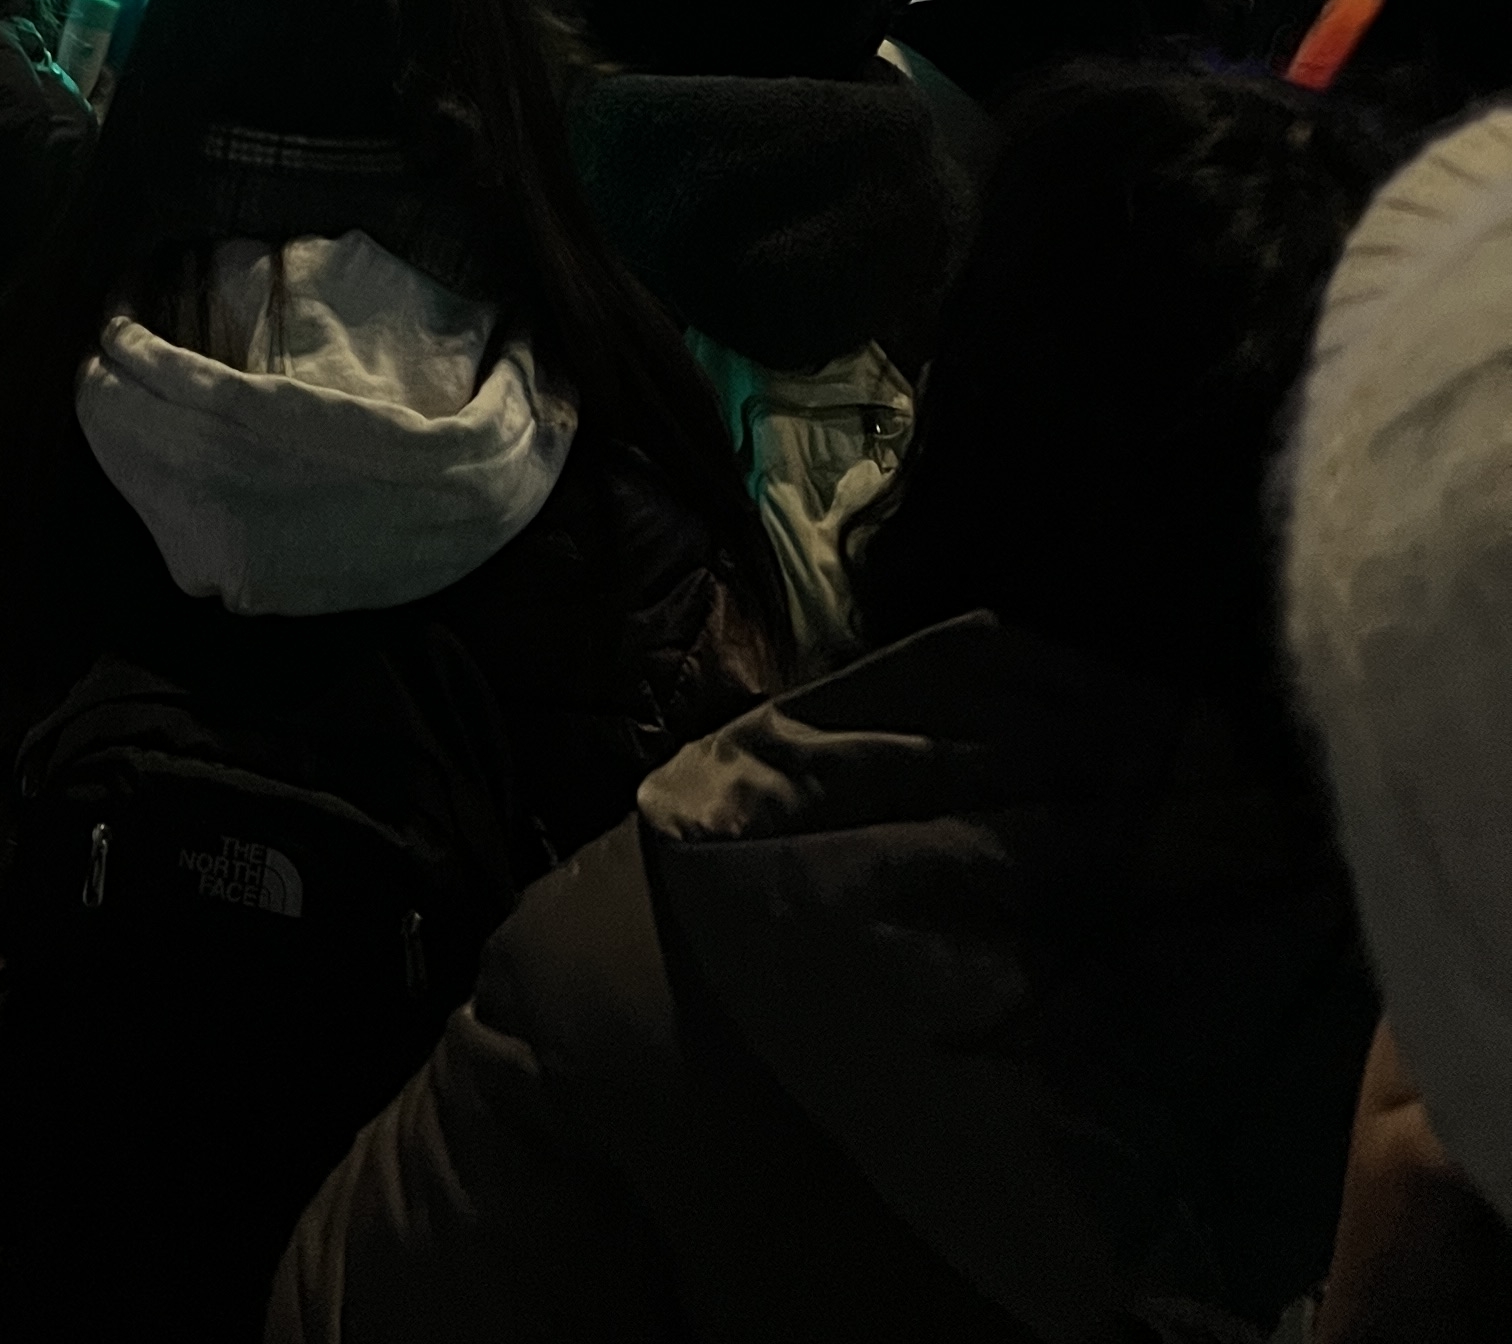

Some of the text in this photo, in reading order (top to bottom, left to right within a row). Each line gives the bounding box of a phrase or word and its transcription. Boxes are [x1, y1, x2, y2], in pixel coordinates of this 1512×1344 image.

[222, 834, 267, 864] THE
[179, 848, 262, 886] NORTH
[199, 873, 259, 908] FACE
